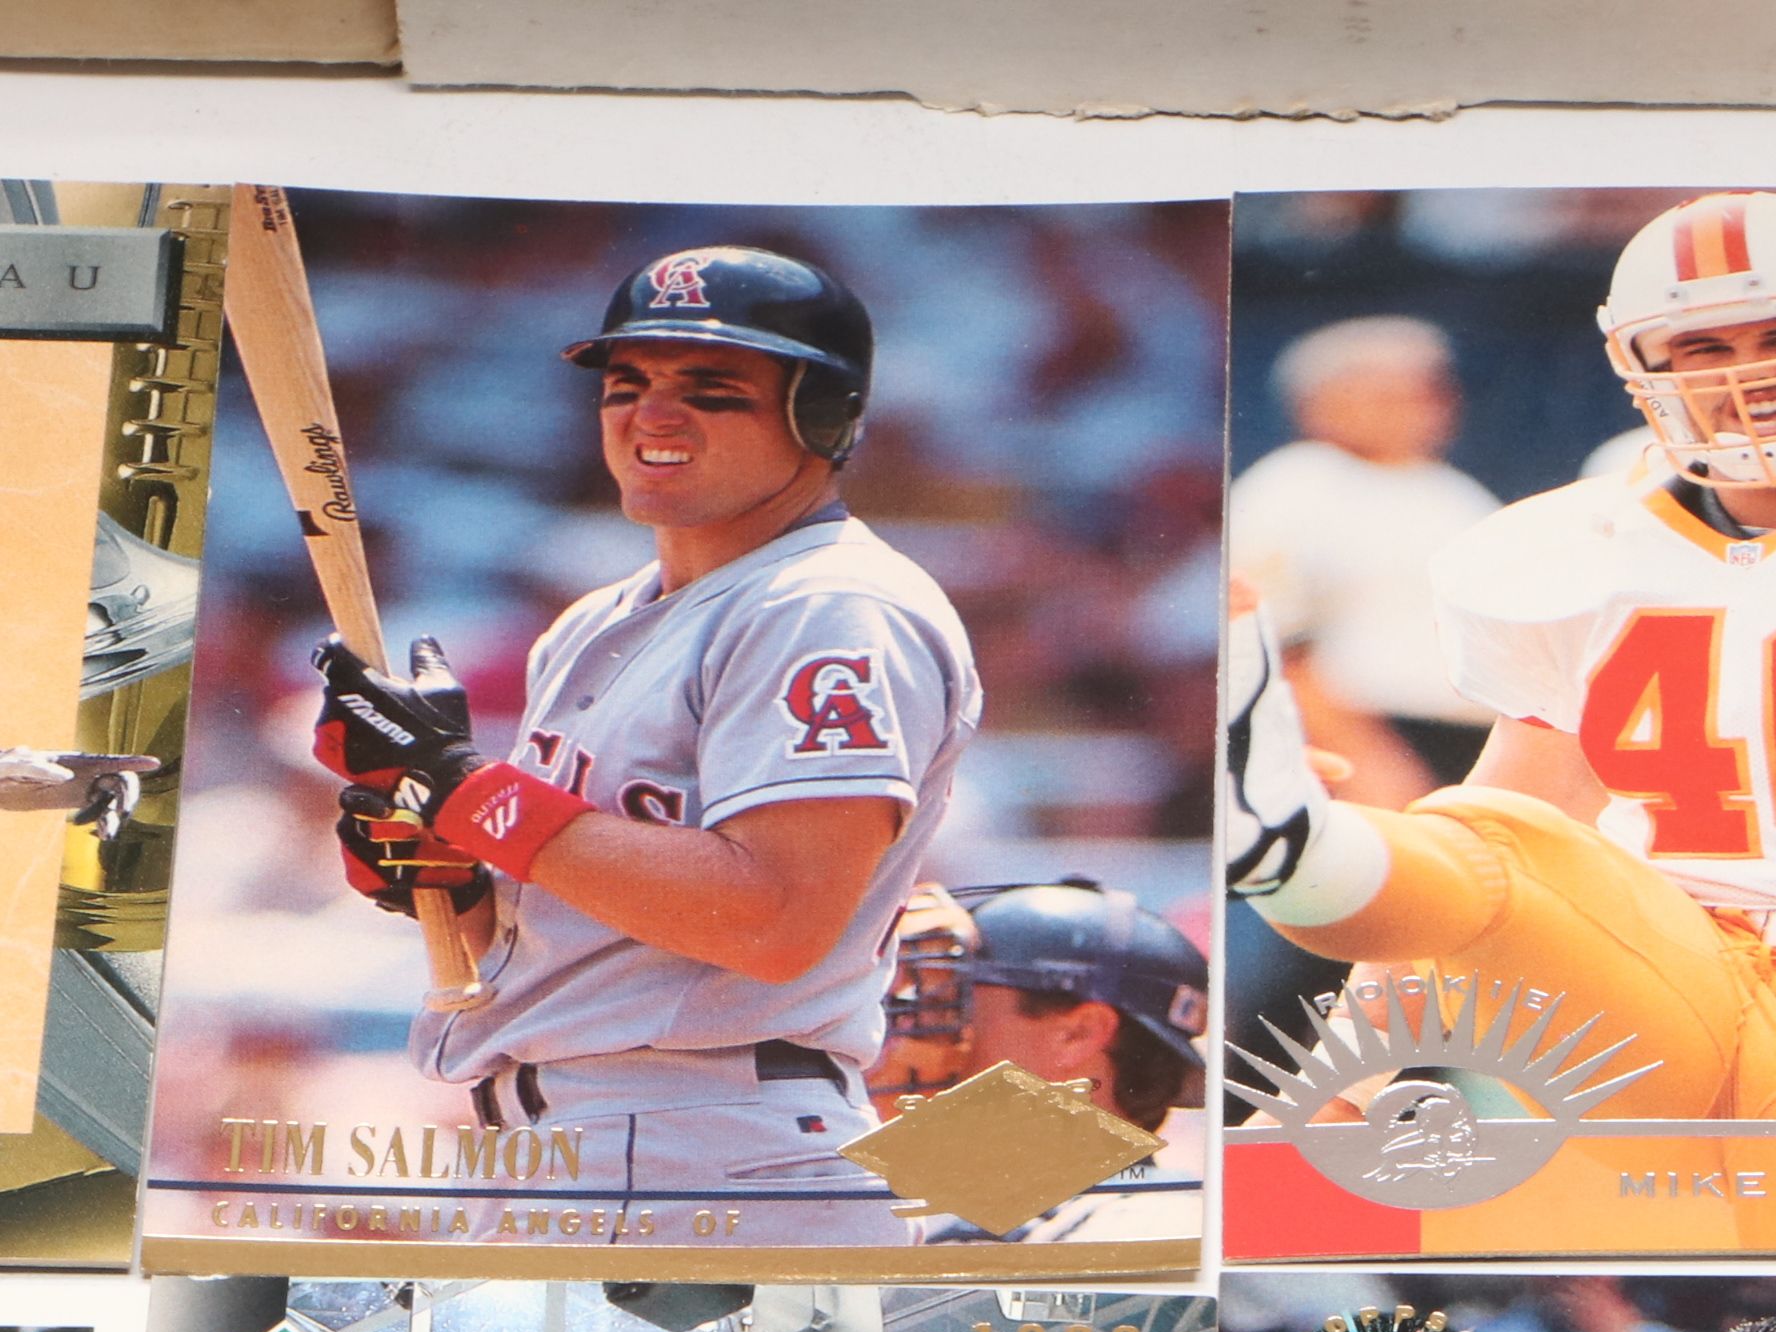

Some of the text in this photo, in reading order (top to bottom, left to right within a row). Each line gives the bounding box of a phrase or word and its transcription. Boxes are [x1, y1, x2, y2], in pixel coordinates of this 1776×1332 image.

[300, 422, 357, 521] Rawlings
[1313, 975, 1549, 1015] ROOKIE
[221, 1118, 583, 1181] TIM SALMON
[1618, 1171, 1767, 1199] MIKE
[210, 1201, 741, 1236] CALIFORNIA ANGELS OF
